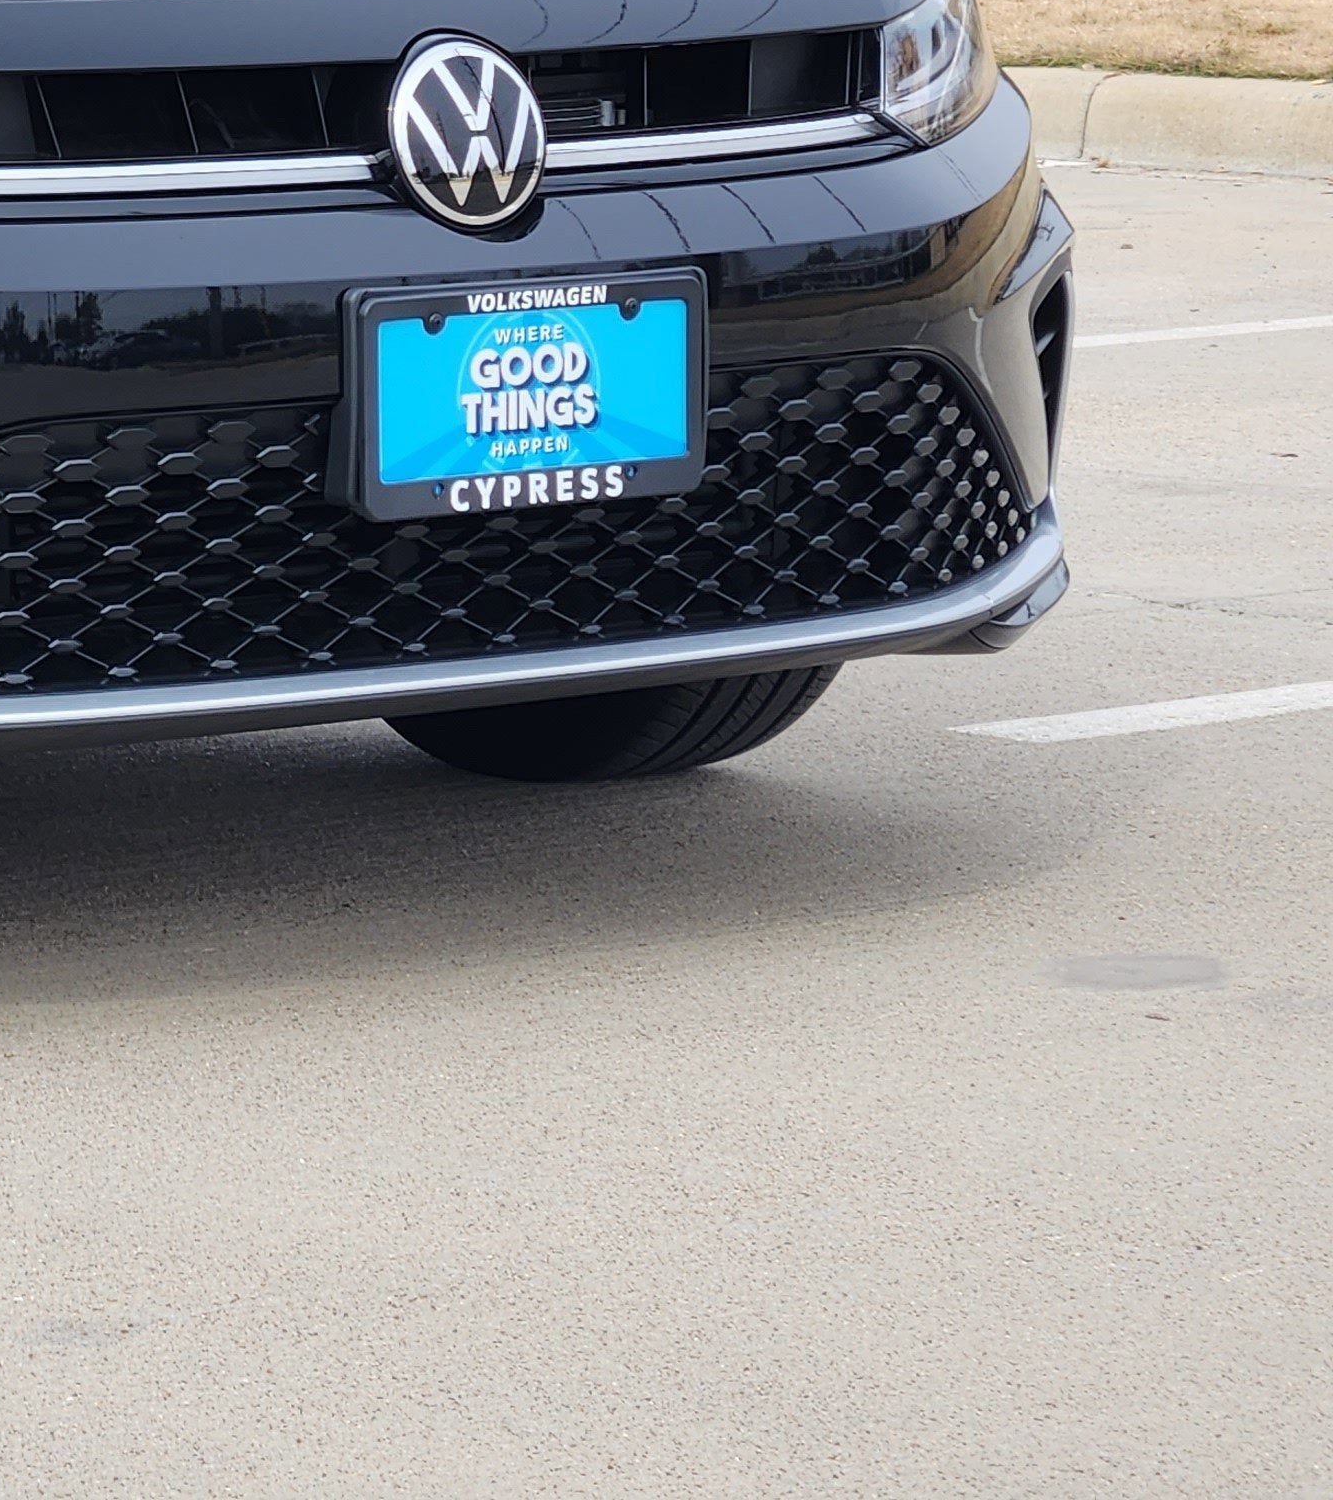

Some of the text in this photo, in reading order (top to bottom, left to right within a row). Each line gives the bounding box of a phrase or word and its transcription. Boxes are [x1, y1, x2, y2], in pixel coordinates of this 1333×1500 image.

[467, 285, 608, 314] VOLKSWAGEN
[494, 323, 565, 346] WHERE
[470, 341, 591, 389] GOOD
[460, 383, 598, 435] THINGS
[490, 435, 570, 458] HAPPEN
[450, 465, 625, 513] CYPRESS
